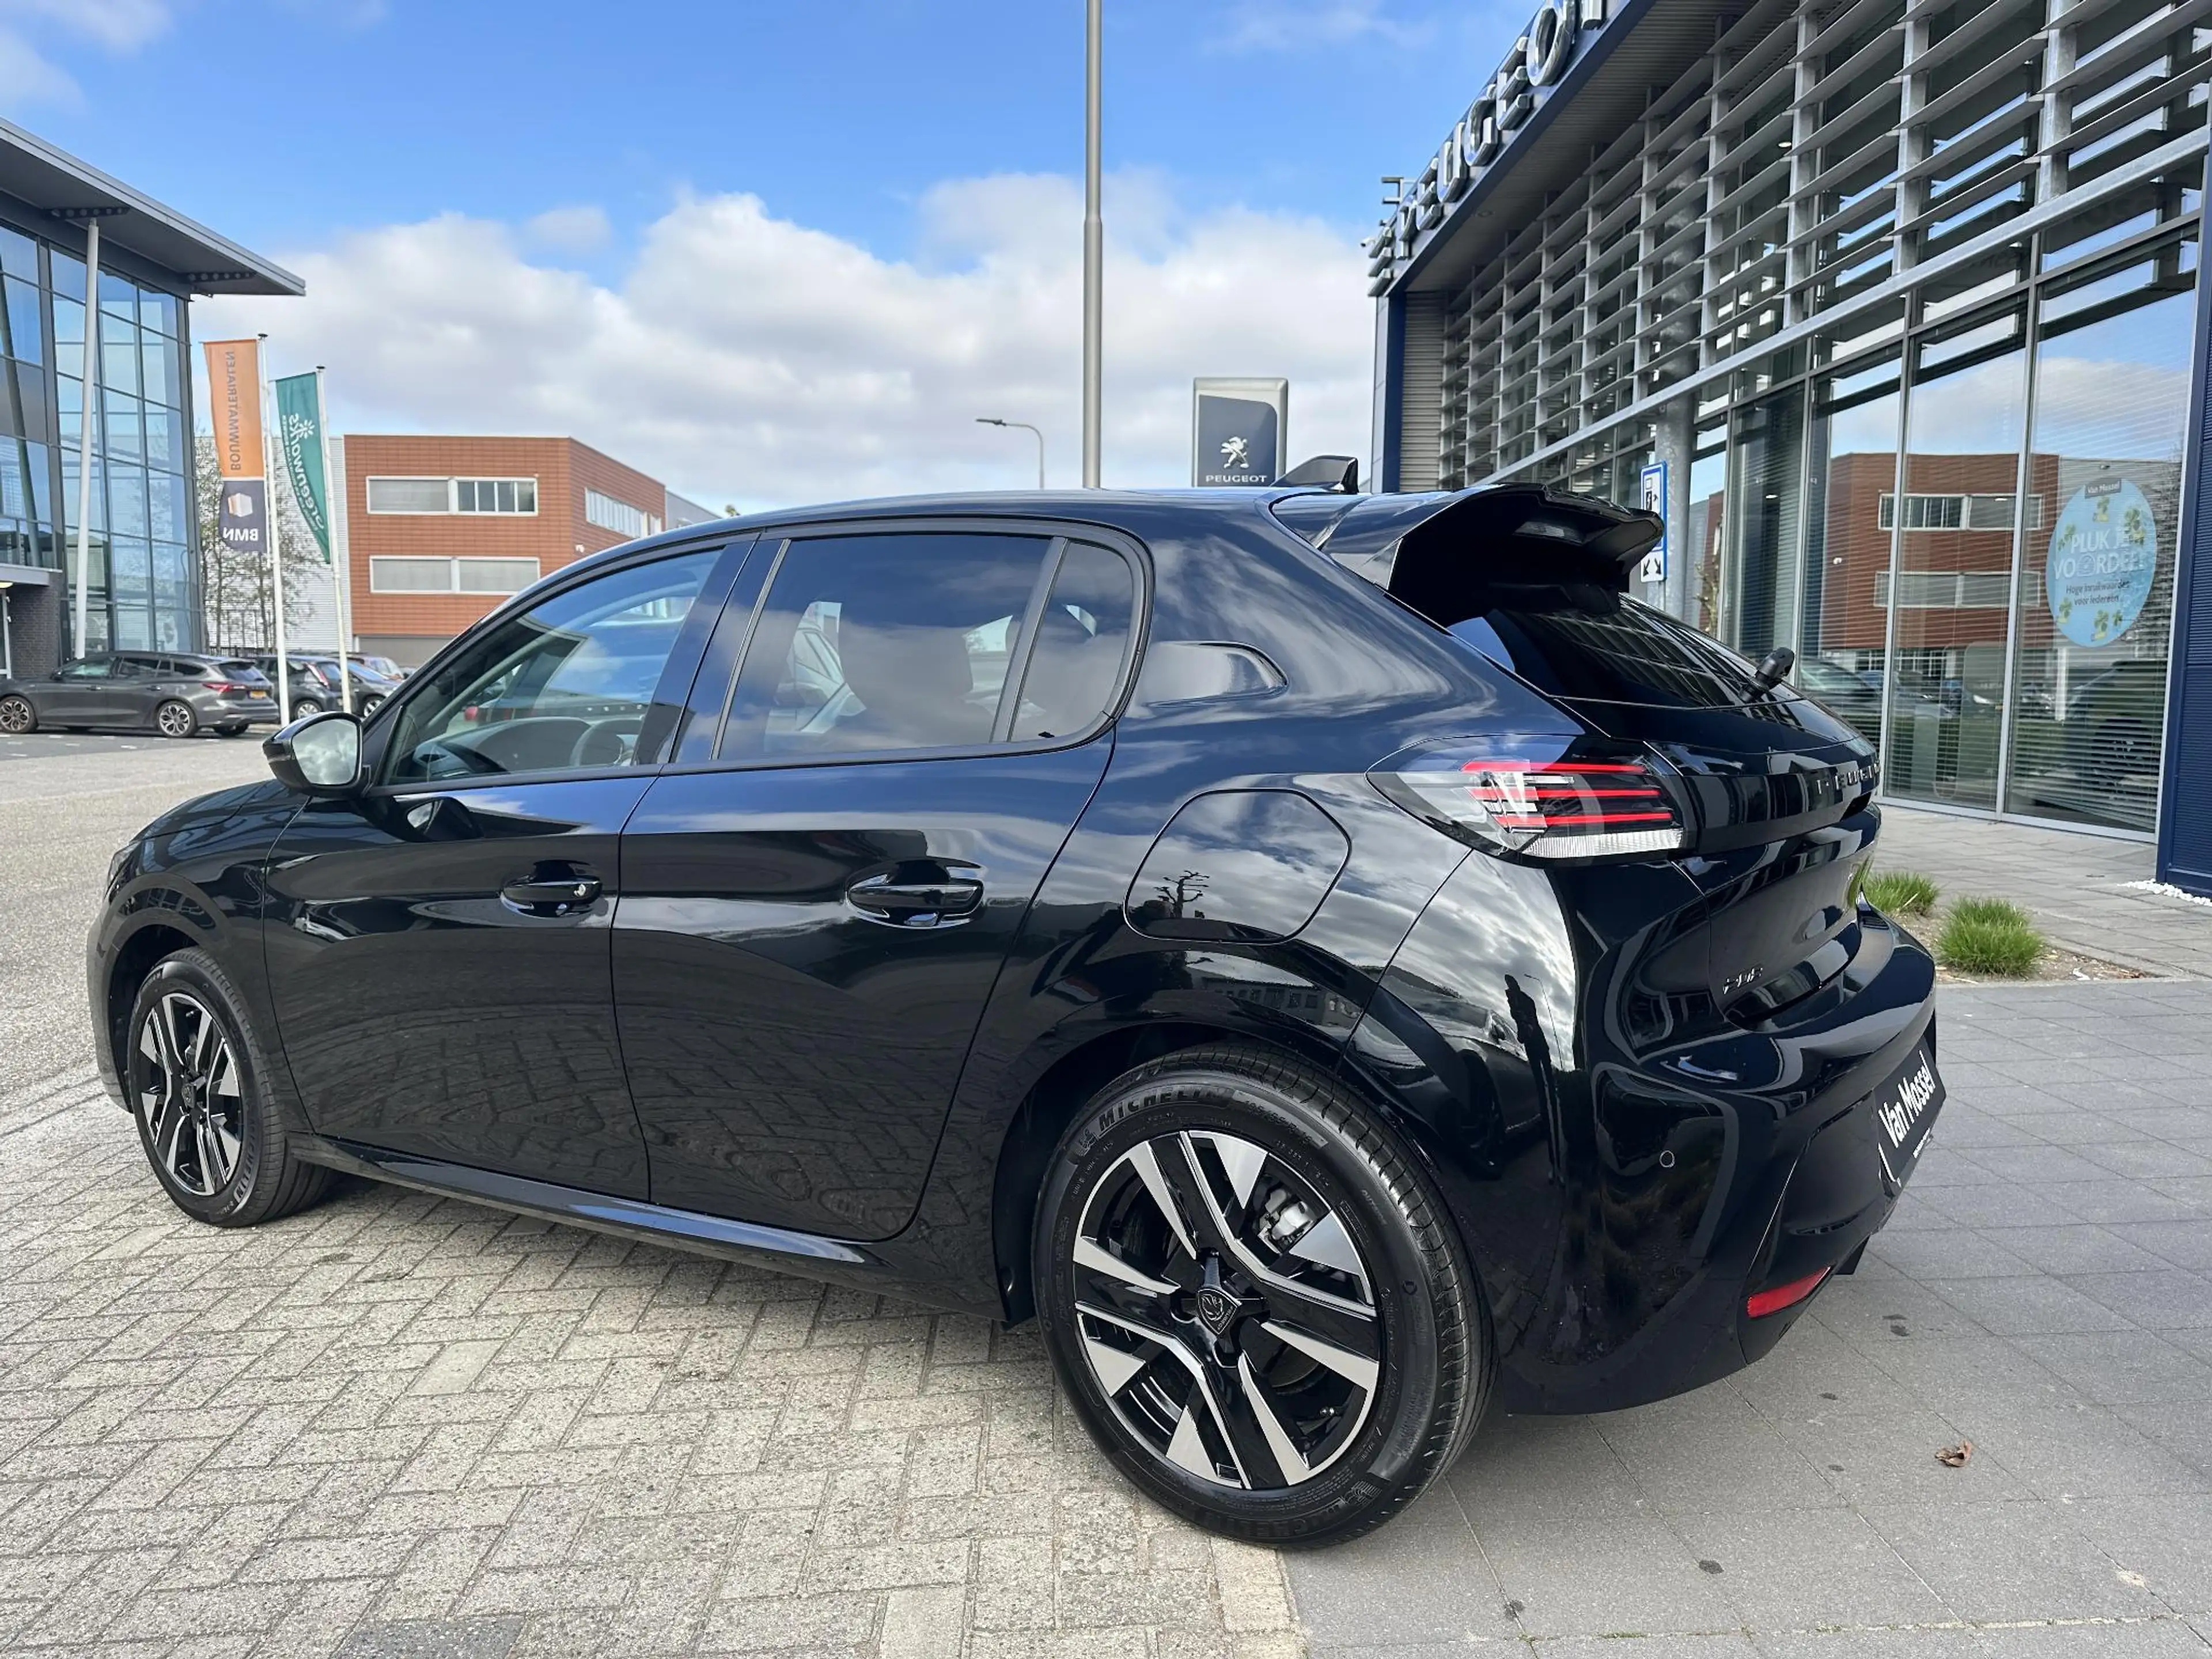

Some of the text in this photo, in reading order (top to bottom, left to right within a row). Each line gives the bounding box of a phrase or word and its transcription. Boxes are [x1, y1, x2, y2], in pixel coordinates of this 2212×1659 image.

[2070, 529, 2111, 554] PLUK
[1099, 1085, 1236, 1131] MICHELIN
[1878, 1101, 1911, 1149] Van
[1897, 1050, 1937, 1124] Mossel
